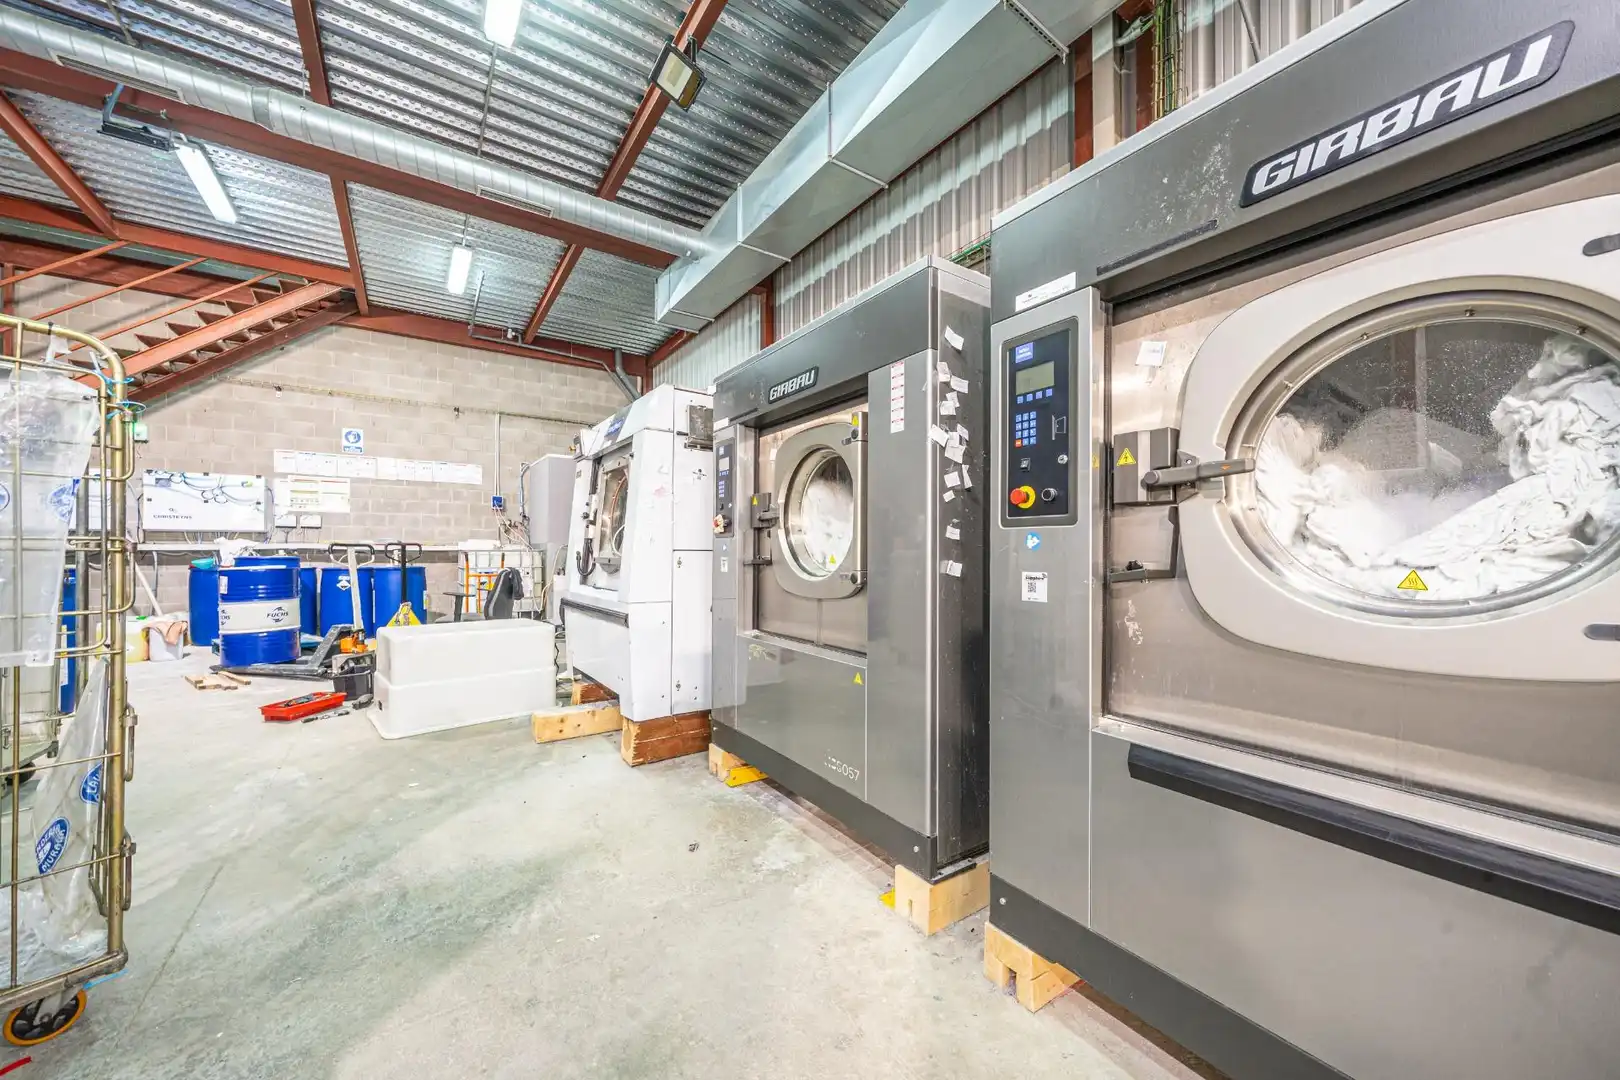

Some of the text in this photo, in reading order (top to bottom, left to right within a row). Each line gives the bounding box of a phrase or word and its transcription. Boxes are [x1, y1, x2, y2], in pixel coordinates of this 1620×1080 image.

[1251, 34, 1553, 196] GIRBAU
[769, 369, 815, 401] GIRBAU
[267, 611, 288, 619] FUCHS
